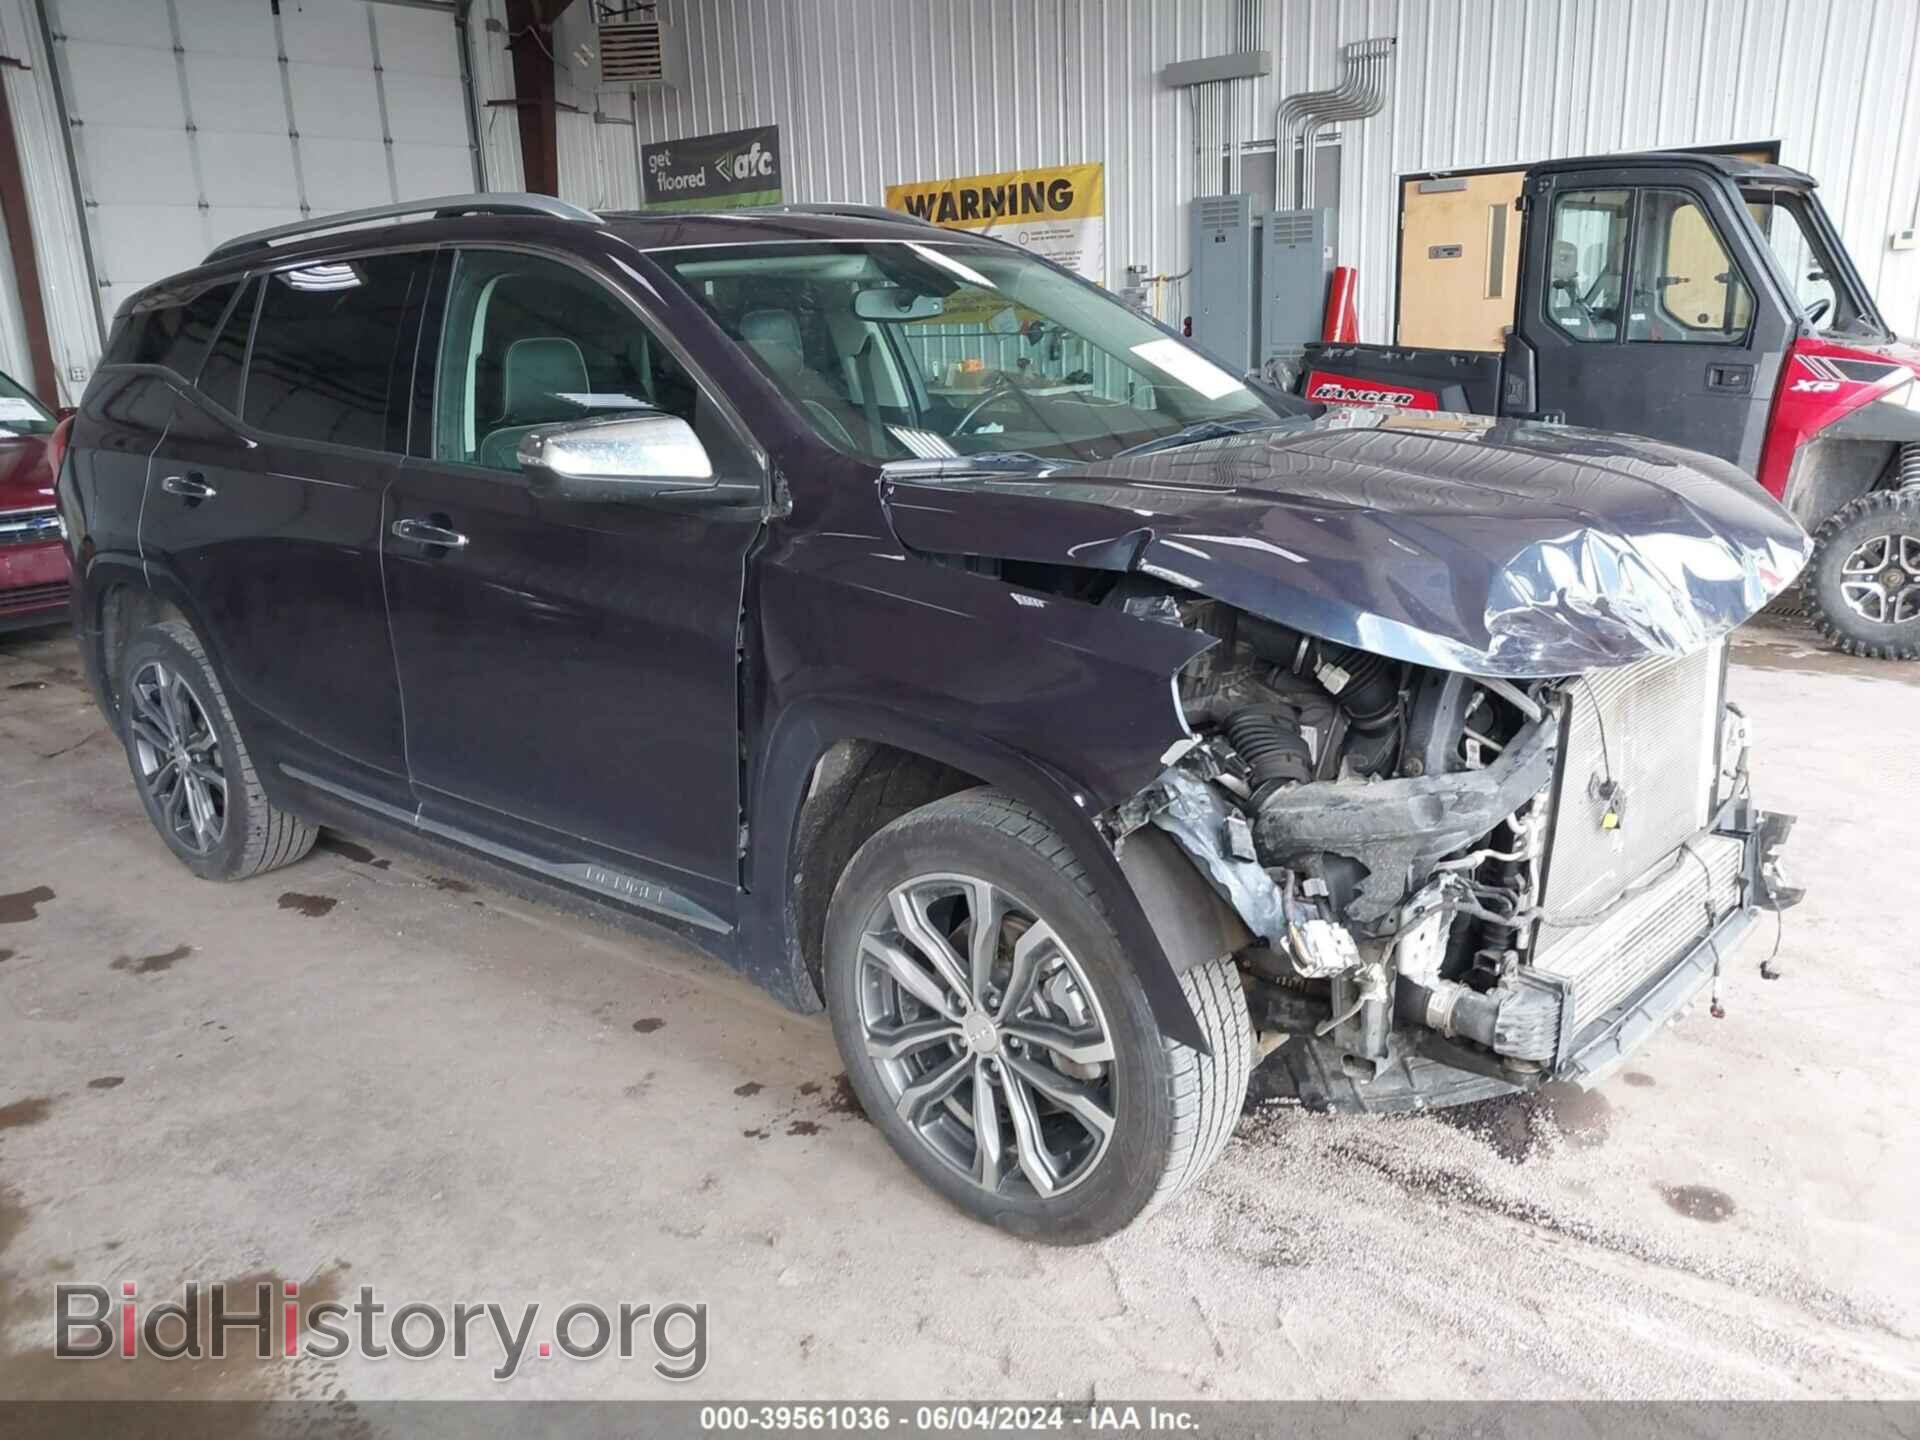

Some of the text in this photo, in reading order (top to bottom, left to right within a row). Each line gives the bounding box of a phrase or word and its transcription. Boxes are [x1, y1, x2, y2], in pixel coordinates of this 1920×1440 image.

[648, 150, 671, 173] get
[734, 142, 773, 180] afc
[657, 166, 706, 192] floored
[904, 178, 1074, 223] WARNING
[1312, 385, 1414, 405] RANGER
[1789, 379, 1840, 393] XP
